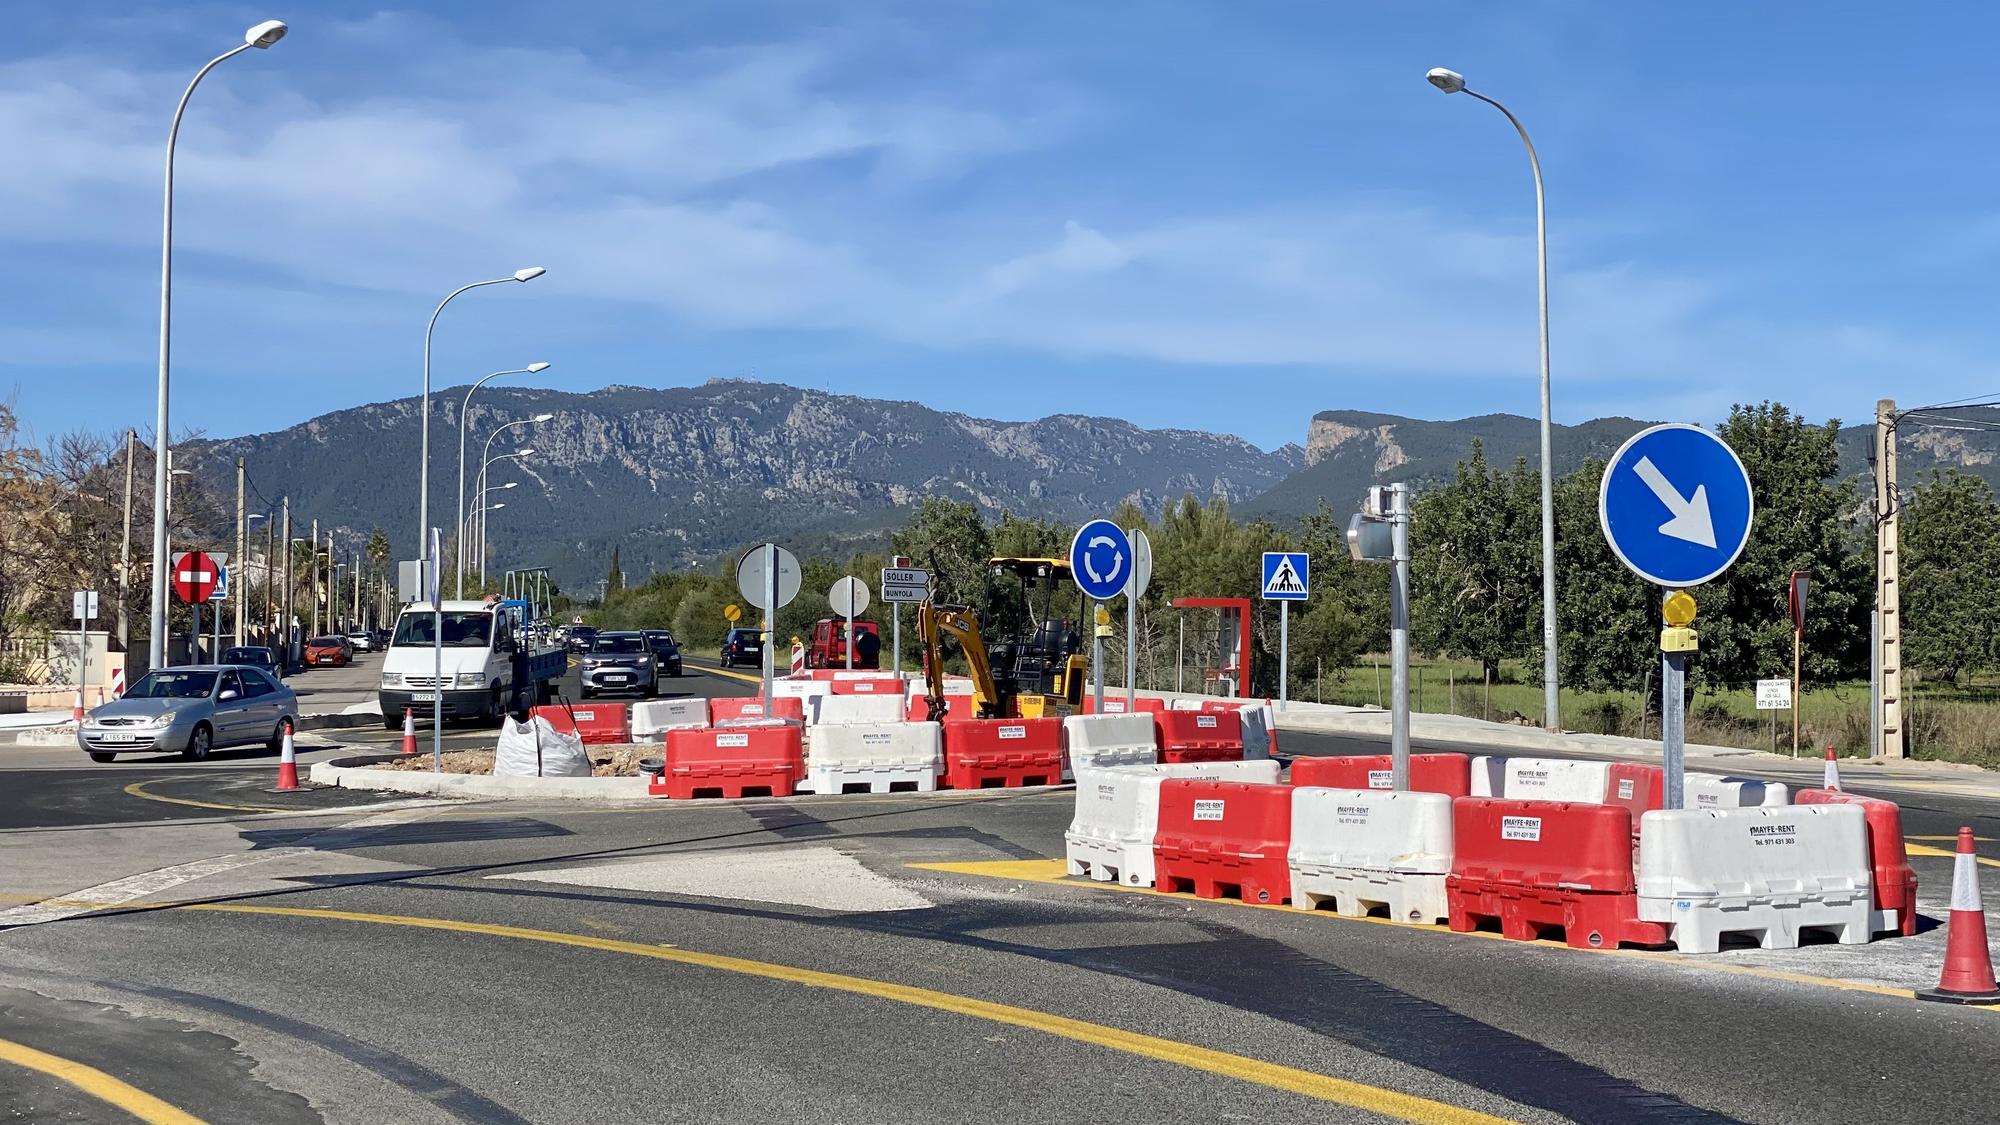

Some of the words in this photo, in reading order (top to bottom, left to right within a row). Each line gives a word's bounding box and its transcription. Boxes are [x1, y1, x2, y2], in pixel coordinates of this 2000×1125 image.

[886, 572, 914, 582] SÓLLER
[886, 590, 913, 598] BUNYOLA
[954, 619, 970, 633] JCB
[1750, 825, 1795, 836] MAYFE-RENT
